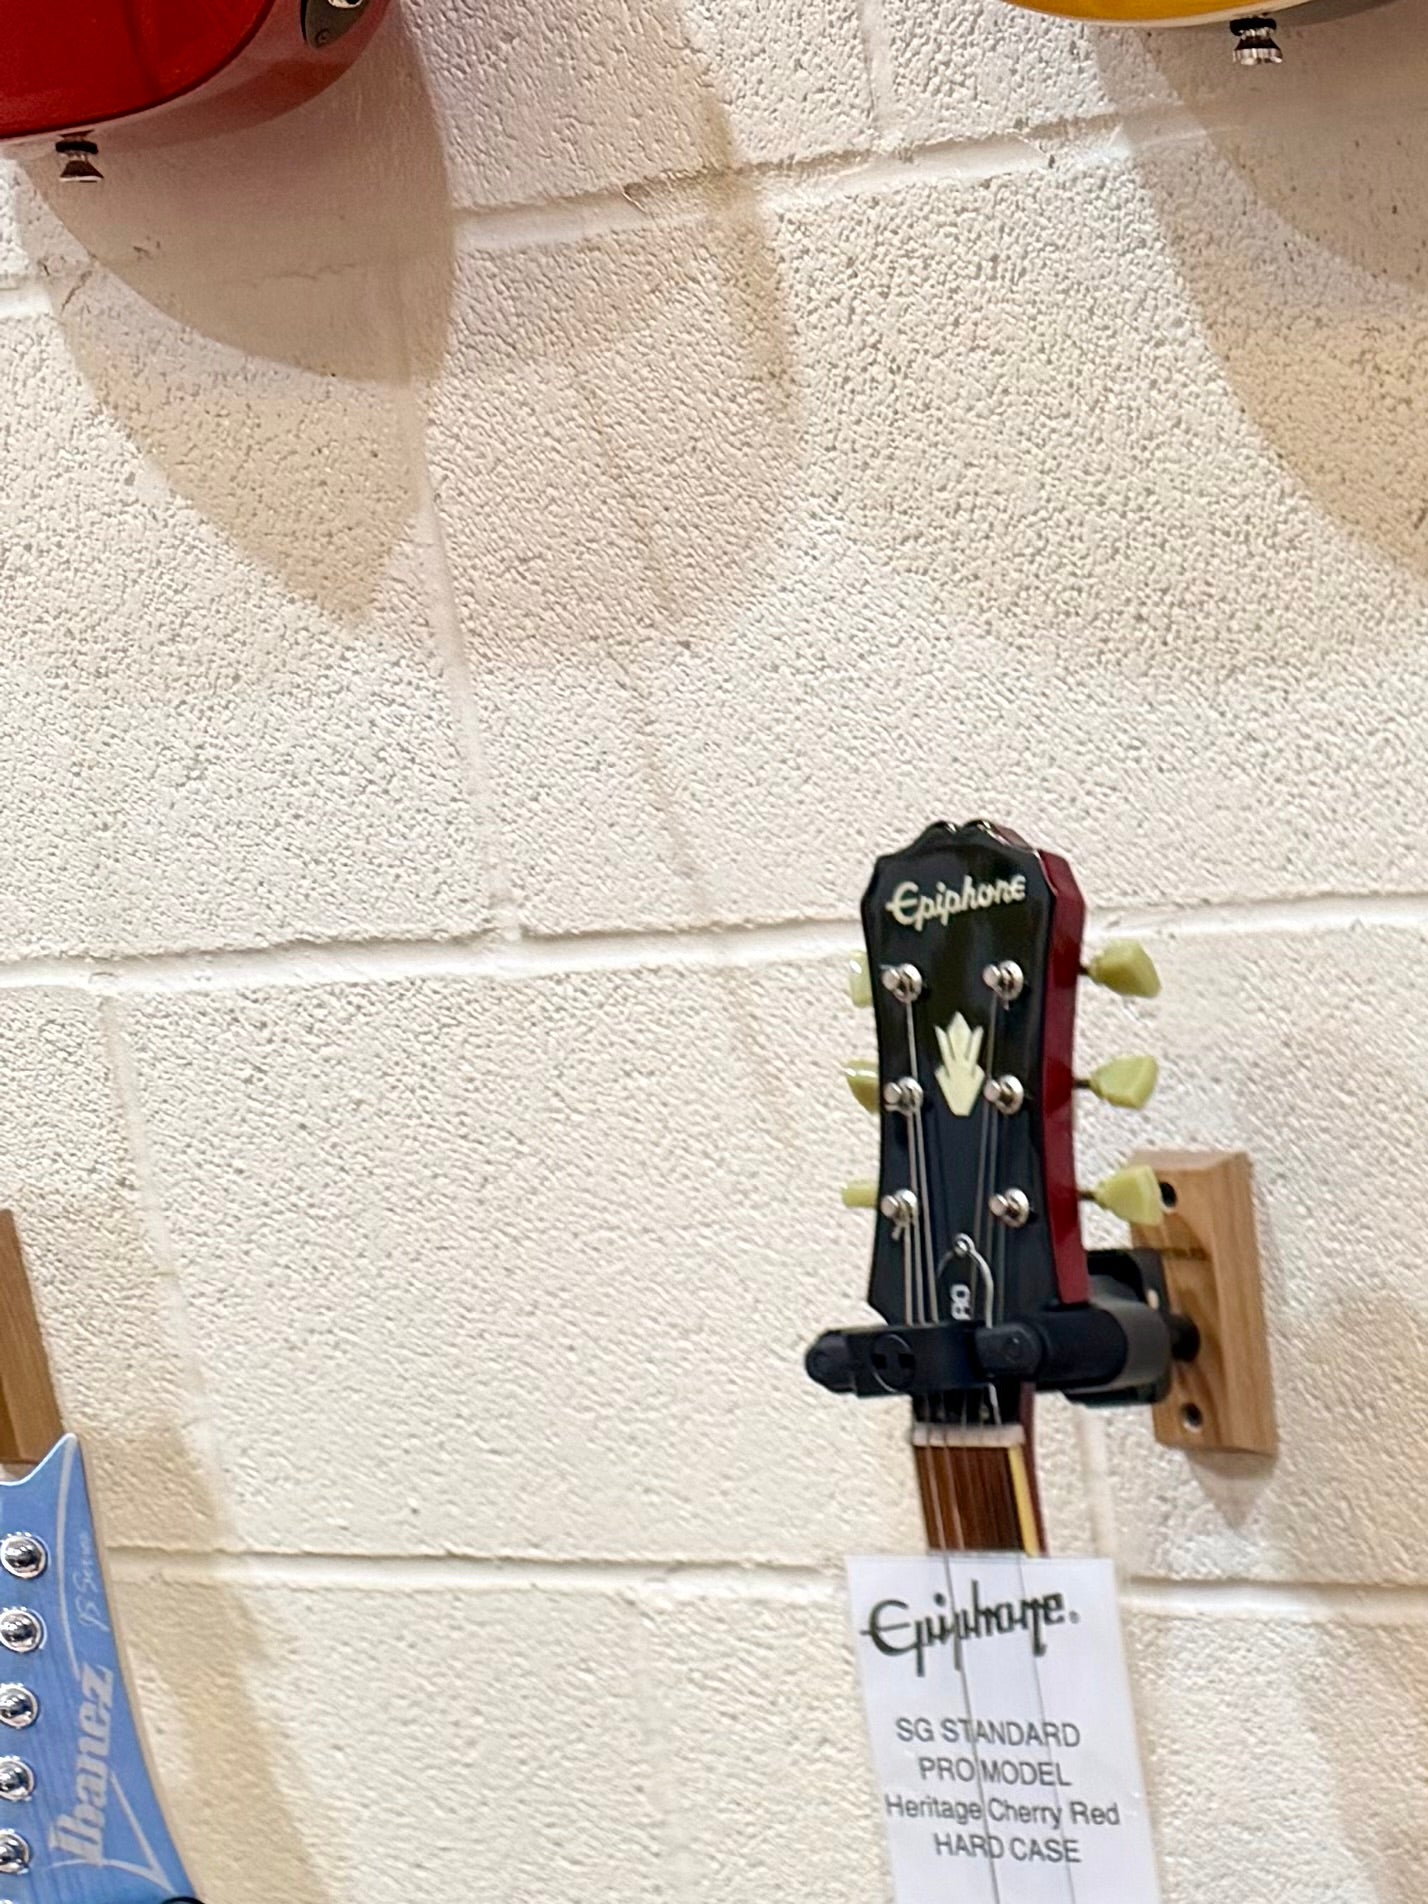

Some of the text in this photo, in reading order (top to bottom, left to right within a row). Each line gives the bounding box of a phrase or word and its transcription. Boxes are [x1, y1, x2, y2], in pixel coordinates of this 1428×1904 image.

[885, 873, 1027, 932] Epiphone
[860, 1579, 1064, 1677] Epiphone
[897, 1717, 1081, 1748] SG STANDARD
[47, 1663, 115, 1868] Ibanez
[919, 1757, 1073, 1787] PRO MODEL
[886, 1793, 1120, 1830] Heritage Cherry Red
[934, 1833, 1082, 1863] HARD CASE
